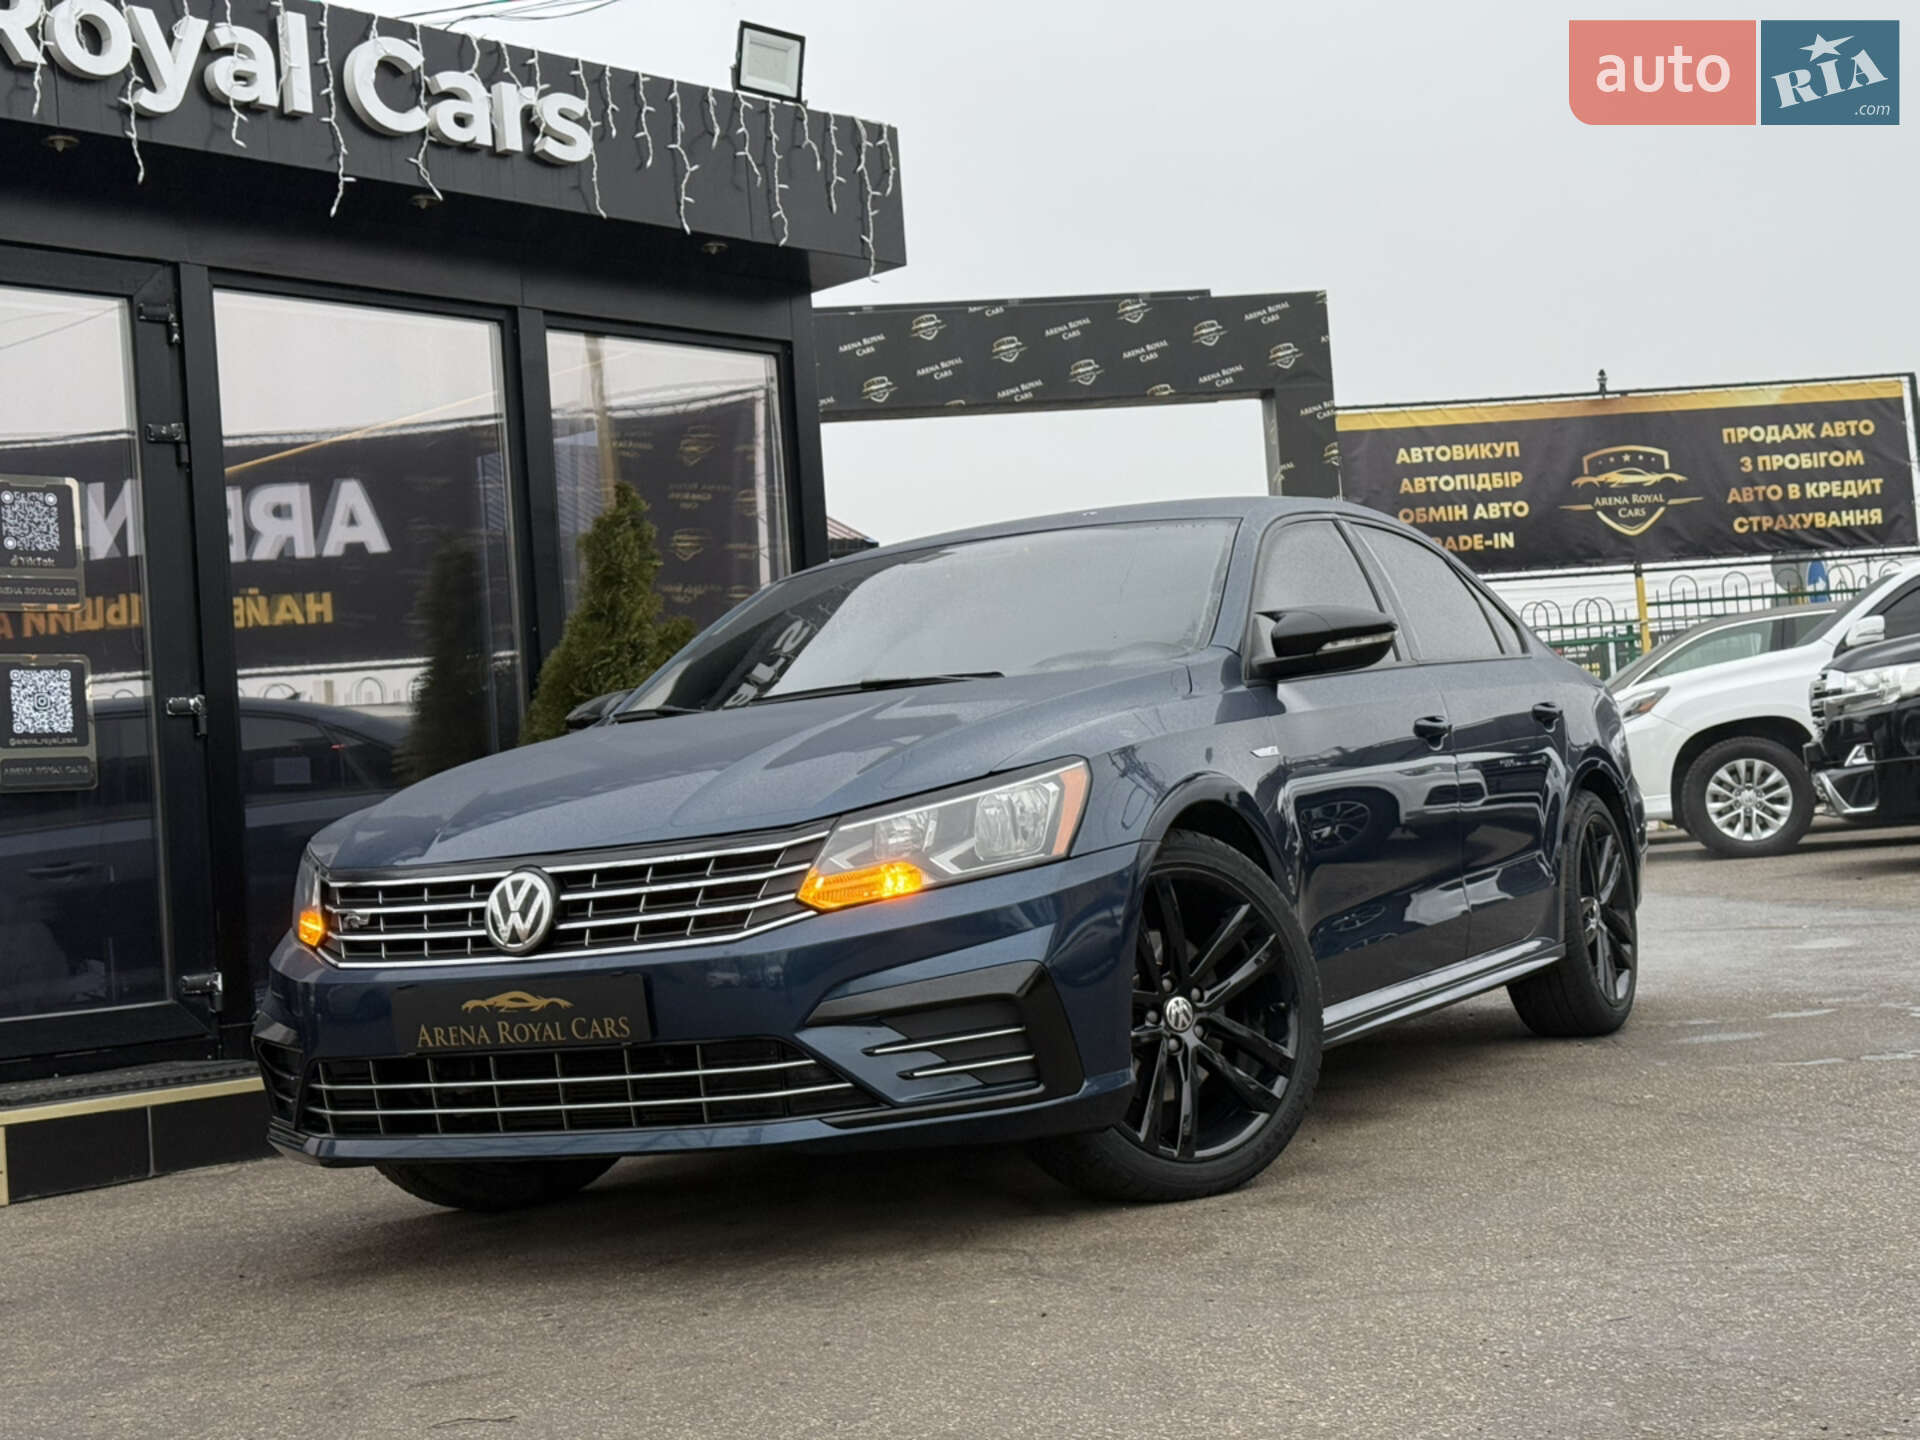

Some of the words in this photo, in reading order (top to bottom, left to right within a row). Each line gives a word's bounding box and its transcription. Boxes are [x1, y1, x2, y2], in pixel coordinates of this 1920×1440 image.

[343, 37, 594, 165] Cars
[1722, 422, 1816, 444] ПРОДАЖ
[1819, 419, 1875, 438] АВТО
[1395, 441, 1520, 464] АВТОВИКУП
[1757, 449, 1864, 471] ПРОБІГОМ
[1400, 471, 1523, 494] АВТОПІДБІР
[1727, 484, 1783, 503] АВТО
[1788, 483, 1801, 500] В
[1805, 478, 1883, 498] КРЕДИТ
[1593, 496, 1629, 507] ARENA
[1631, 493, 1665, 503] ROYAL
[1398, 504, 1468, 524] ОБМІН
[1473, 500, 1530, 520] АВТО
[1617, 507, 1647, 519] CARS
[1733, 508, 1883, 533] СТРАХУВАННЯ
[1432, 531, 1515, 552] ADE-IN
[417, 1024, 491, 1047] ARENA
[497, 1021, 566, 1044] ROYAL
[571, 1016, 631, 1039] CARS
